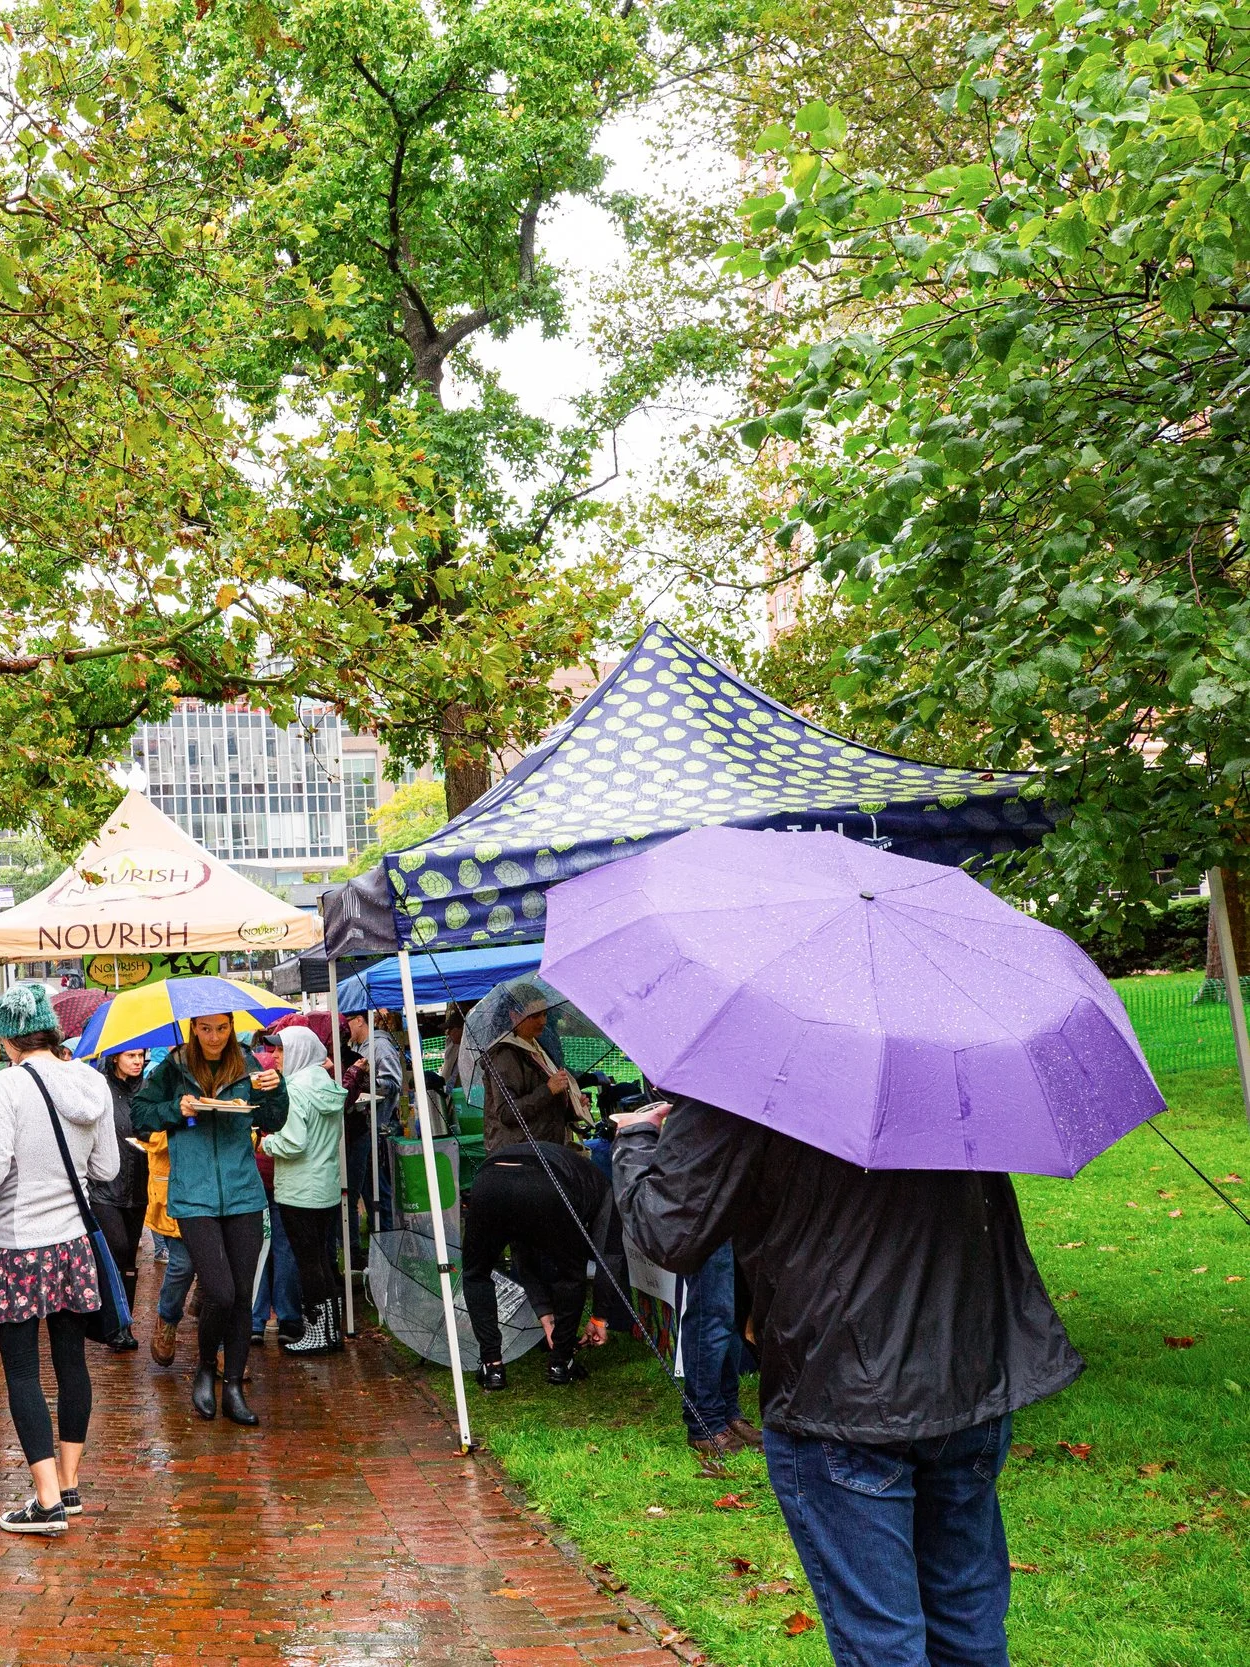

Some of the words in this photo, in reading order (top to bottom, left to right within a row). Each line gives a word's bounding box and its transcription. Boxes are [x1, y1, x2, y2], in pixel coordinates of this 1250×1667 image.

[66, 868, 189, 898] NOURISH
[38, 921, 189, 951] NOURISH
[243, 926, 284, 936] NOURISH
[94, 961, 145, 974] NOURISH
